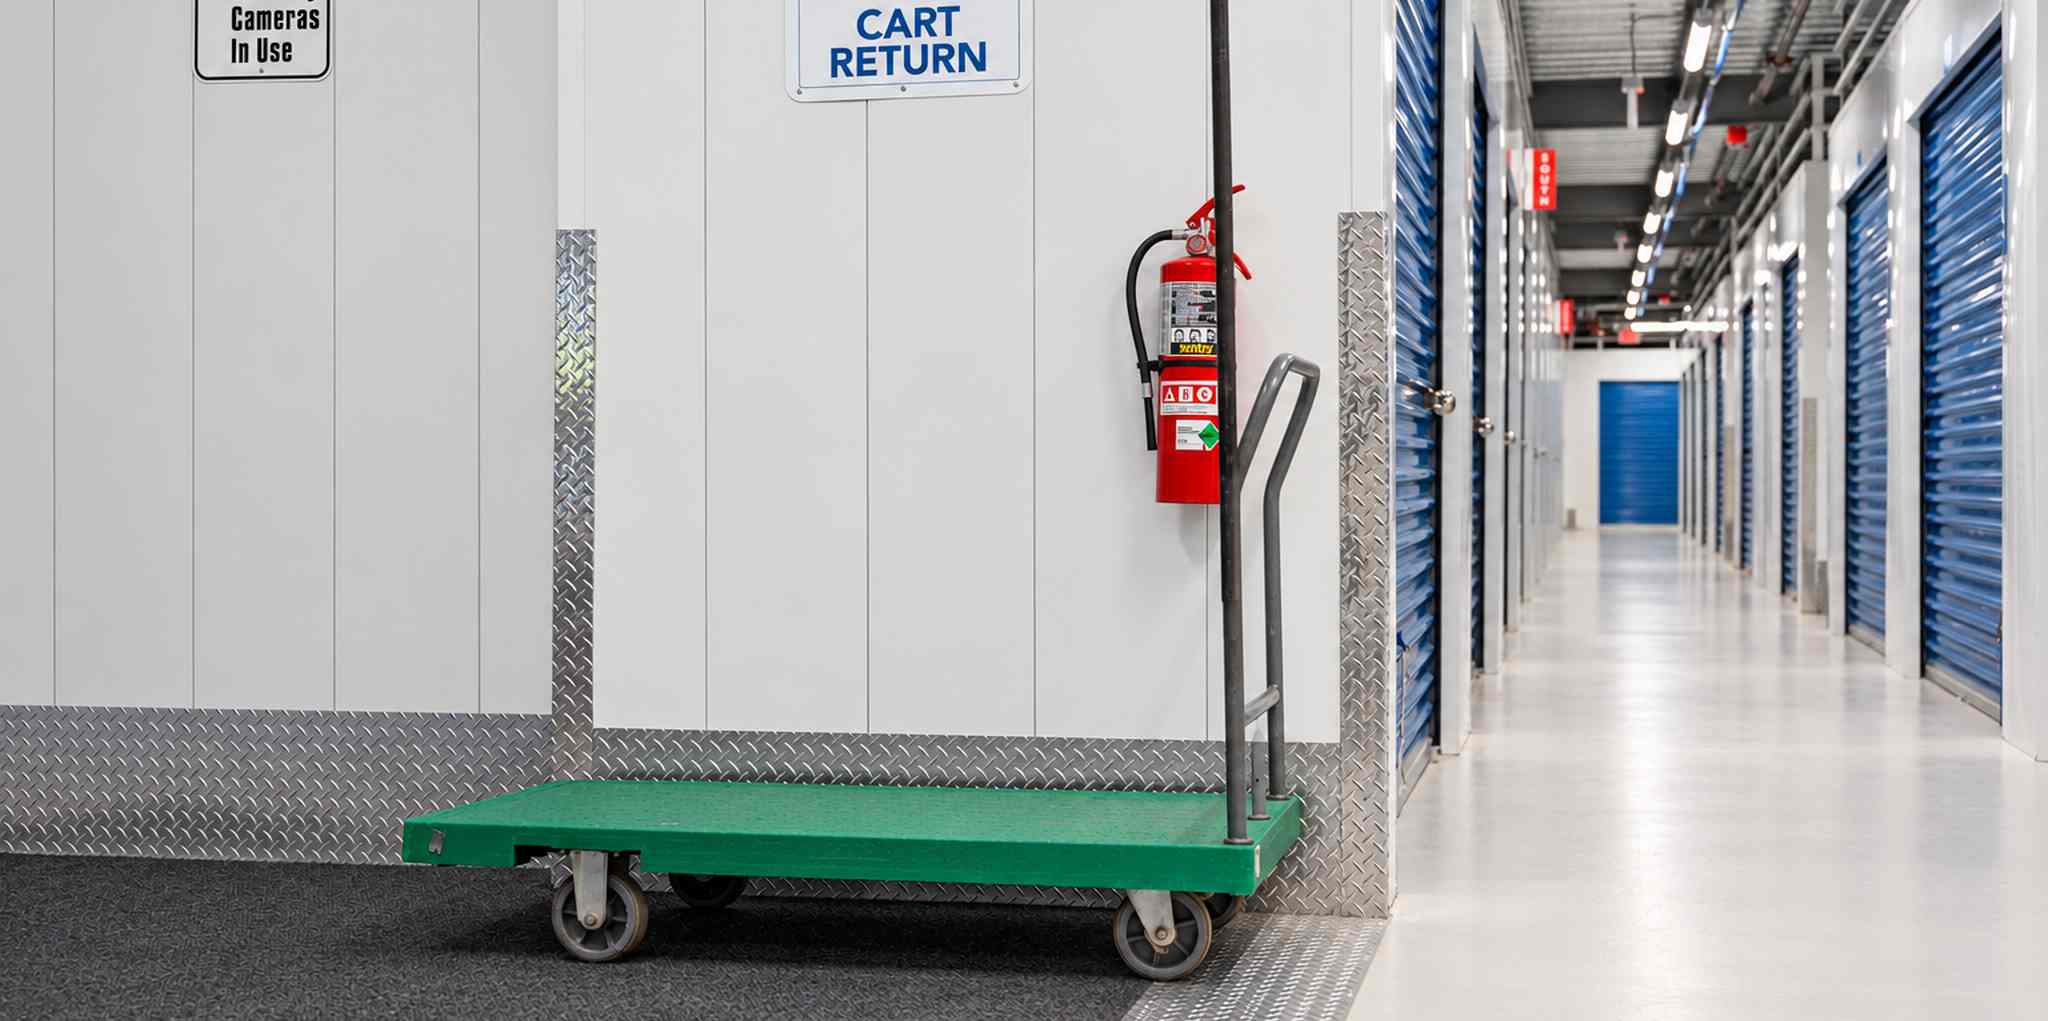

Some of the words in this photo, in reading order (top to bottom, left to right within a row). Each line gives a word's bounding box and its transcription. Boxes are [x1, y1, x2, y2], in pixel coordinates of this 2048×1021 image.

[231, 6, 320, 31] Cameras
[857, 6, 960, 40] CART
[231, 38, 249, 63] In
[257, 37, 292, 62] Use
[830, 42, 987, 78] RETURN
[1539, 152, 1551, 206] SOUTH
